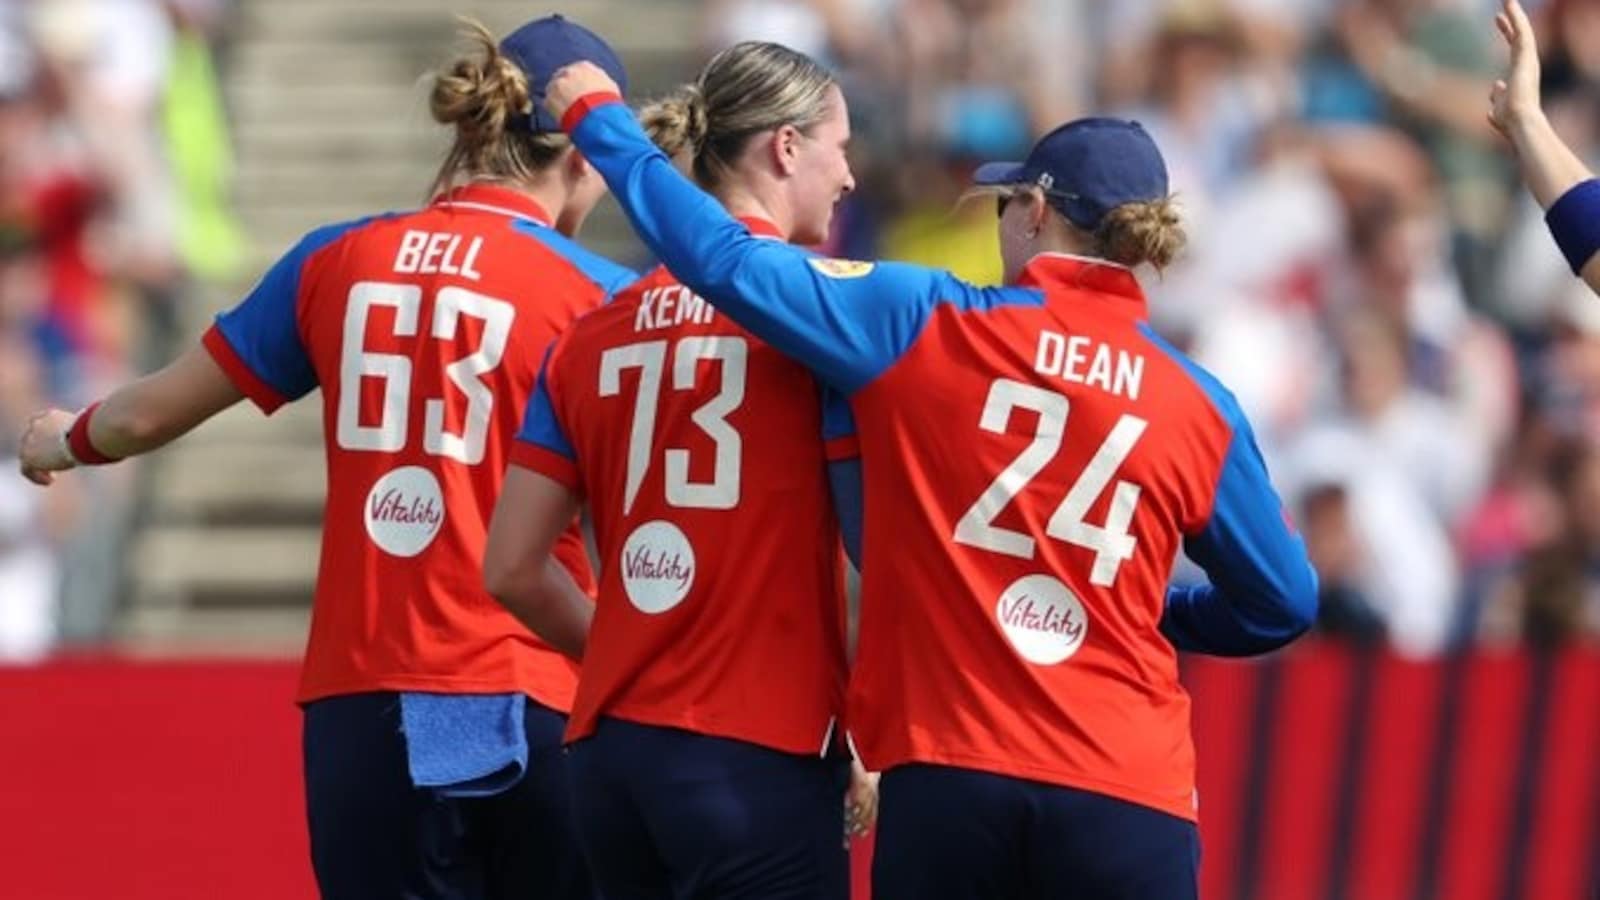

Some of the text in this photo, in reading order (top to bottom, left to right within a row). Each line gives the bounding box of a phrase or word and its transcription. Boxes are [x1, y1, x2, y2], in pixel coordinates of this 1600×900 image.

[393, 229, 484, 281] BELL
[337, 281, 516, 465] 63
[1035, 329, 1145, 401] DEAN
[599, 336, 748, 516] 73
[371, 487, 441, 534] Vitality
[953, 378, 1149, 588] 24
[625, 544, 691, 590] Vitality
[1001, 594, 1083, 645] Vitality
